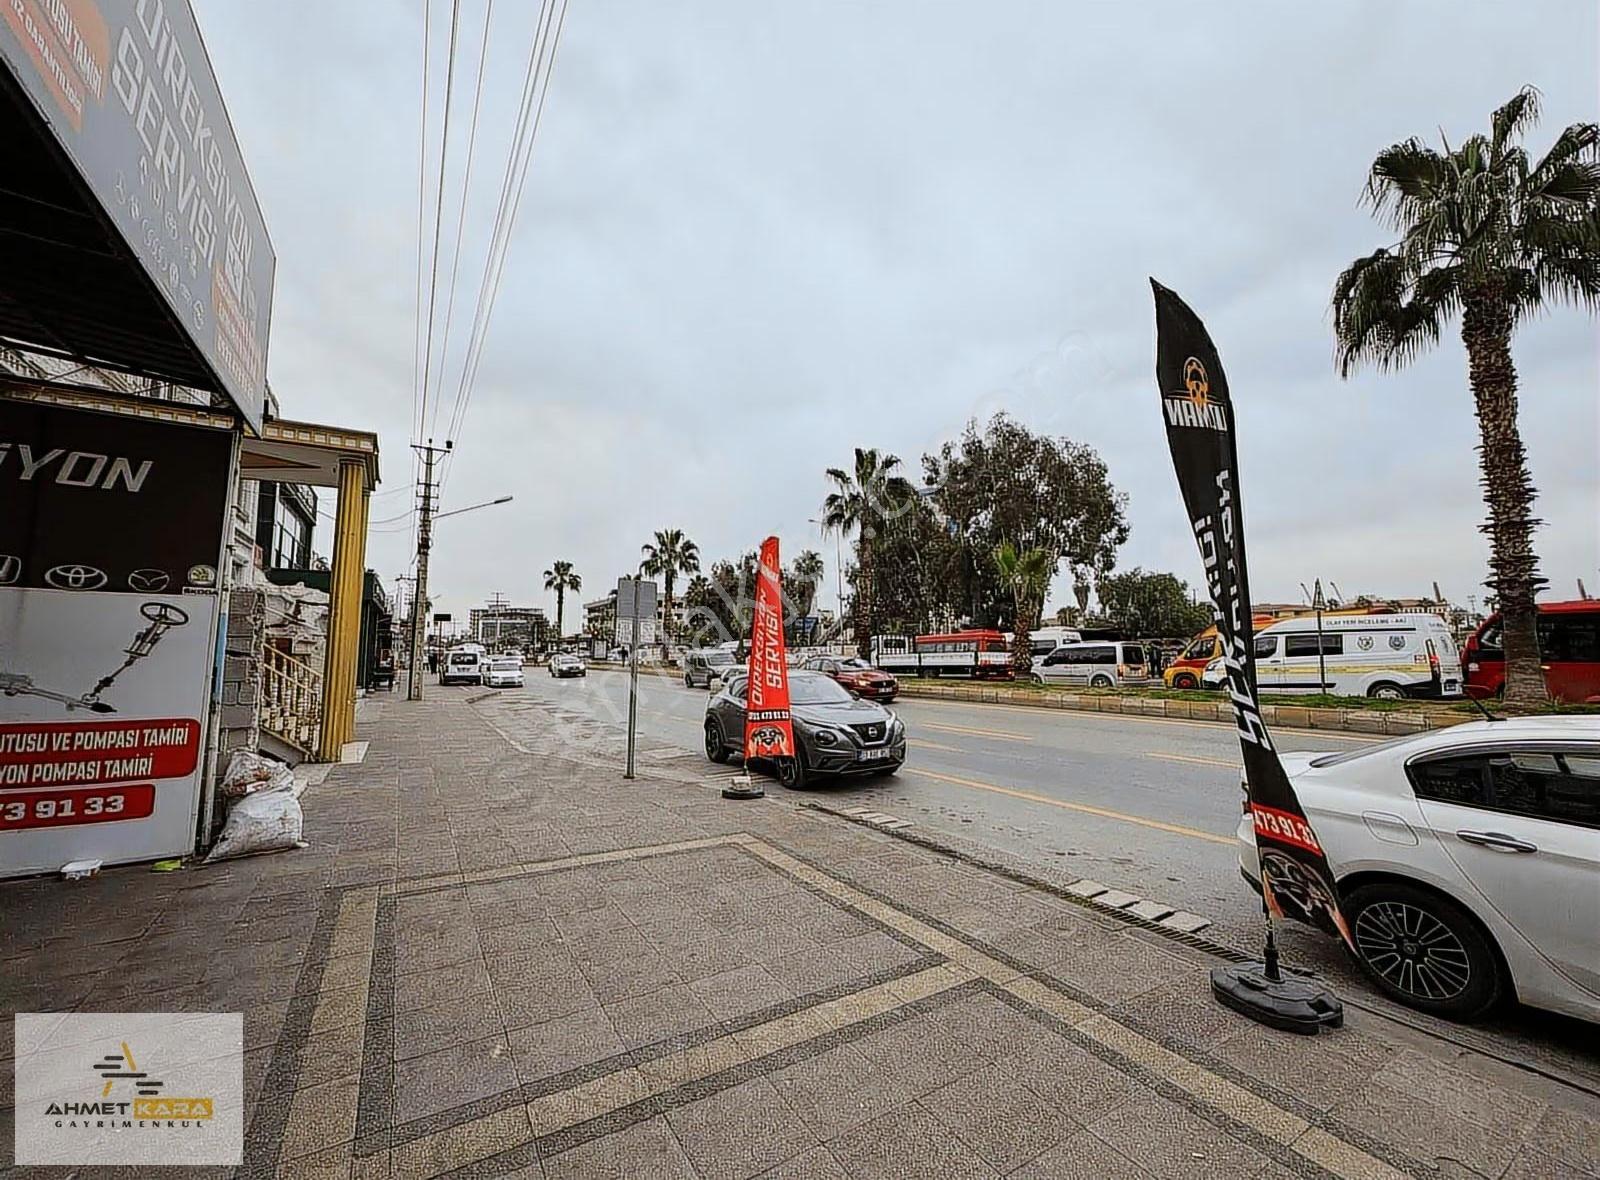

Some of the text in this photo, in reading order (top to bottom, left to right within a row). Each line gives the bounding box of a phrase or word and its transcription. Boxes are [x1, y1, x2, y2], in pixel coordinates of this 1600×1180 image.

[53, 732, 72, 751] VE
[74, 729, 139, 750] POMPASI
[143, 723, 190, 746] TAMİRİ
[32, 761, 100, 783] POMPASI
[105, 753, 153, 778] TAMİRİ
[36, 800, 76, 819] 91
[84, 795, 125, 815] 33
